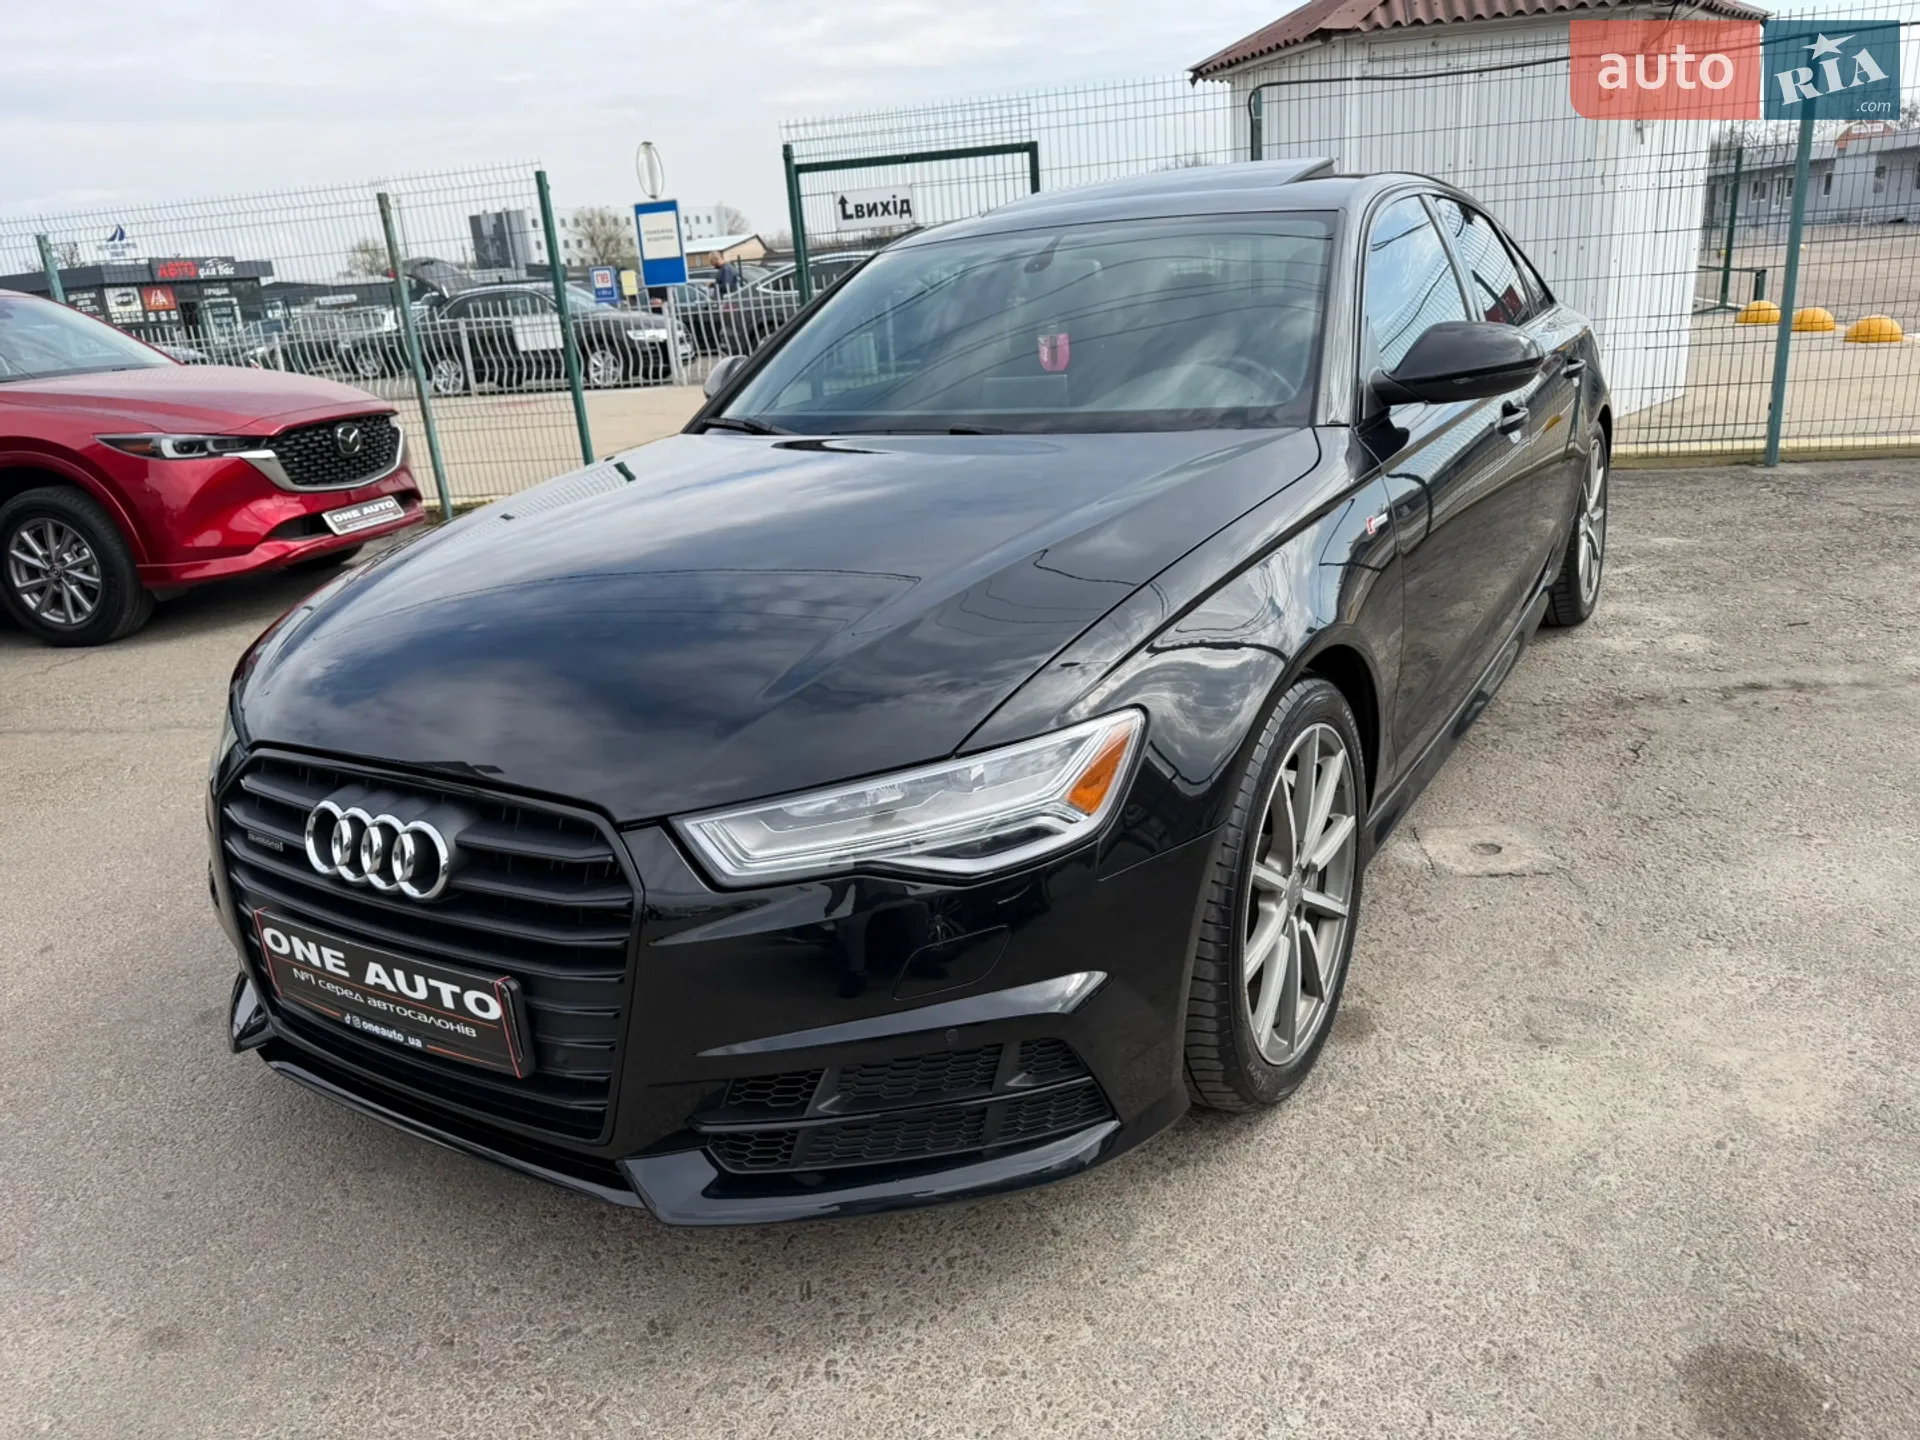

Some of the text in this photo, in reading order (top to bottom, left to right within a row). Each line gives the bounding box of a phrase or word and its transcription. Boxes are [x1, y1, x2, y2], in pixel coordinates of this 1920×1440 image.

[854, 194, 912, 219] вихід
[333, 510, 360, 522] ONE
[363, 501, 394, 514] AUTO
[262, 927, 502, 1020] ONE AUTO
[318, 979, 365, 1003] серед
[367, 996, 478, 1038] автосалонів
[362, 1020, 423, 1048] oneauto_ua
